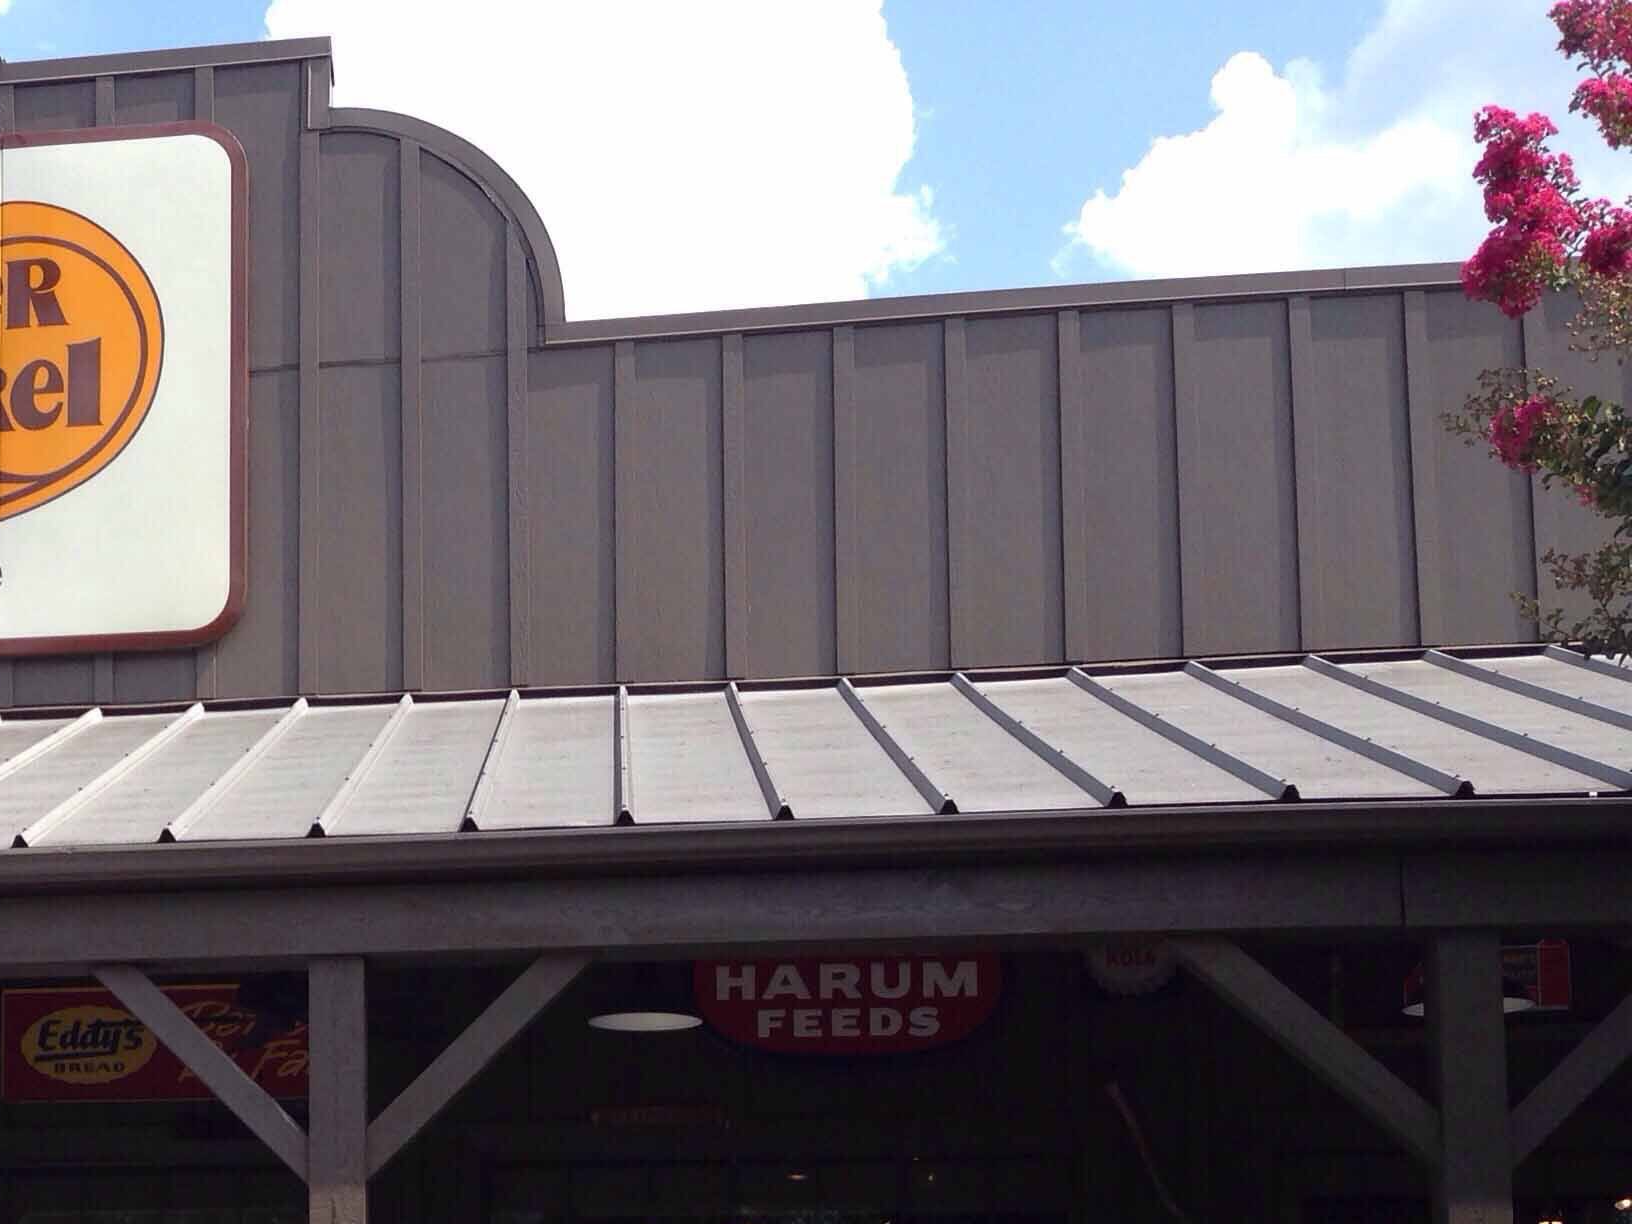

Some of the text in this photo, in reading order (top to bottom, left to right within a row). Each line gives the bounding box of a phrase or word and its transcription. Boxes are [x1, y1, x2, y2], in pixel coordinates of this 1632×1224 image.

[714, 961, 980, 1001] HARUM
[35, 1018, 145, 1056] Eddy's
[757, 1007, 941, 1039] FEEDS
[54, 1061, 125, 1074] BREAD
